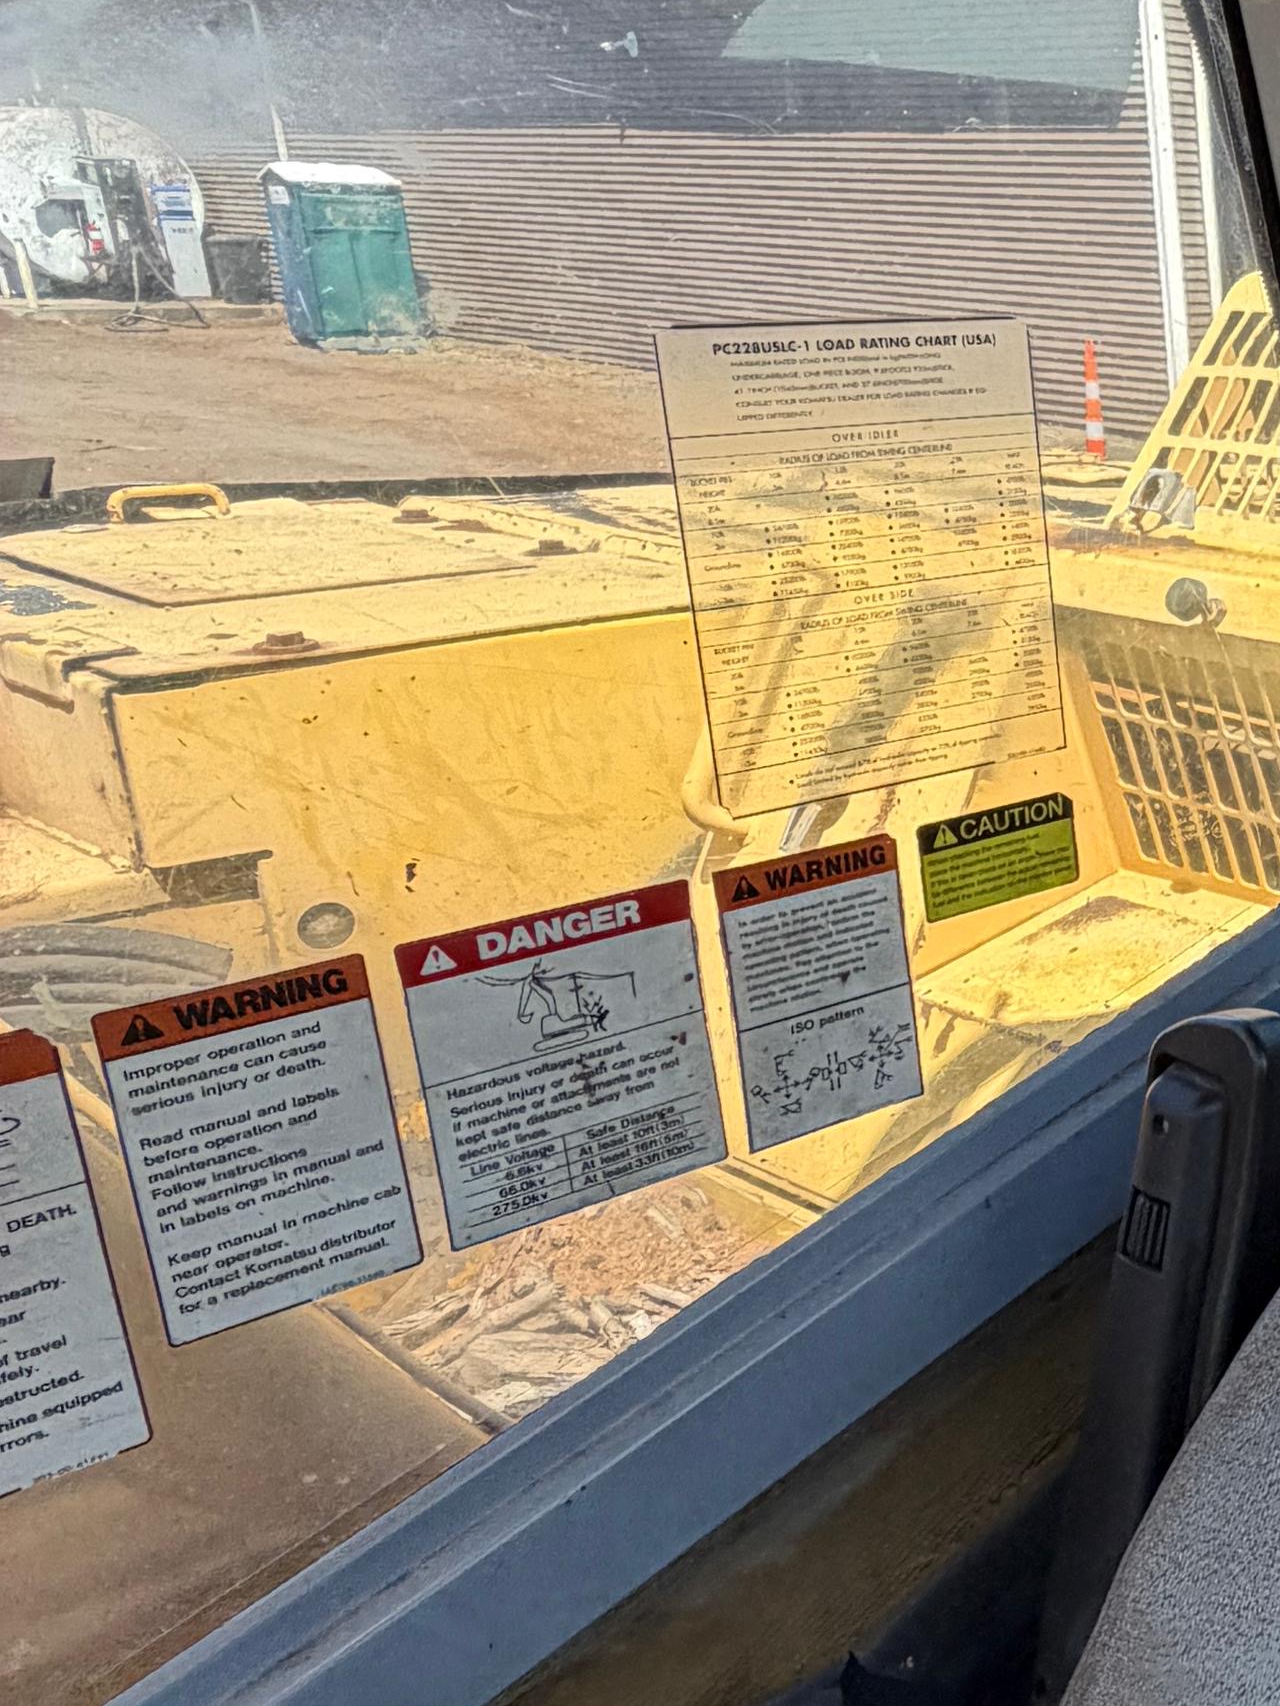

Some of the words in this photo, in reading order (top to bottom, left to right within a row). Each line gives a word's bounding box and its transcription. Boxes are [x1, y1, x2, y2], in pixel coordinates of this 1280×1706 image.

[816, 339, 854, 351] LOAD
[860, 336, 910, 349] RATING
[915, 335, 958, 347] CHART
[962, 333, 996, 348] (USA)
[832, 430, 864, 443] OVER
[960, 793, 1064, 840] CAUTION
[764, 844, 887, 893] WARNING
[476, 899, 640, 961] DANGER
[173, 968, 348, 1029] WARNING
[791, 1018, 815, 1035] ISO
[819, 1005, 865, 1030] pattern
[123, 1052, 201, 1082] Improper
[207, 1031, 286, 1060] operation
[291, 1021, 321, 1038] and
[128, 1062, 238, 1099] maintenance
[244, 1054, 274, 1069] can
[279, 1040, 327, 1059] cause
[131, 1091, 195, 1116] serious
[201, 1077, 248, 1099] injury
[253, 1070, 269, 1082] or
[276, 1057, 326, 1077] death.
[447, 1073, 520, 1101] Hazardous
[450, 1096, 503, 1118] Serious
[551, 1078, 563, 1089] or
[613, 1058, 635, 1071] can
[640, 1046, 674, 1062] occur
[467, 1102, 527, 1128] machine
[532, 1098, 544, 1109] or
[636, 1066, 656, 1079] are
[661, 1056, 680, 1072] not
[139, 1129, 183, 1150] Read
[189, 1110, 251, 1137] manual
[257, 1100, 287, 1118] and
[292, 1086, 340, 1108] labels
[144, 1144, 199, 1167] before
[204, 1120, 283, 1152] operation
[288, 1109, 318, 1126] and
[456, 1130, 486, 1147] kept
[491, 1121, 520, 1136] safe
[527, 1102, 582, 1121] distance
[625, 1080, 655, 1095] from
[586, 1125, 616, 1140] Safe
[621, 1106, 676, 1129] Distance
[148, 1147, 262, 1184] maintenance.
[458, 1141, 510, 1161] electric
[470, 1160, 500, 1176] Line
[506, 1143, 555, 1165] Voltage
[579, 1146, 592, 1157] At
[597, 1133, 629, 1152] least
[581, 1161, 595, 1172] At
[600, 1149, 630, 1166] least
[152, 1177, 206, 1201] Follow
[212, 1148, 308, 1183] instructions
[157, 1199, 187, 1218] and
[192, 1177, 268, 1206] warnings
[293, 1150, 351, 1177] manual
[356, 1139, 384, 1157] and
[583, 1175, 598, 1186] At
[603, 1164, 632, 1180] least
[6, 1204, 77, 1232] DEATH.
[181, 1205, 231, 1228] labels
[236, 1197, 256, 1210] on
[261, 1176, 335, 1202] machine.
[167, 1245, 211, 1267] Keep
[217, 1223, 277, 1251] manual
[302, 1196, 369, 1224] machine
[172, 1264, 209, 1283] near
[215, 1240, 290, 1271] operator.
[175, 1270, 241, 1299] Contact
[245, 1246, 317, 1276] Komatsu
[320, 1218, 396, 1252] distributor
[179, 1299, 202, 1314] for
[207, 1295, 218, 1306] a
[223, 1258, 325, 1299] replacement
[329, 1237, 390, 1264] manual.
[15, 1335, 67, 1361] travel
[41, 1381, 123, 1418] equipped
